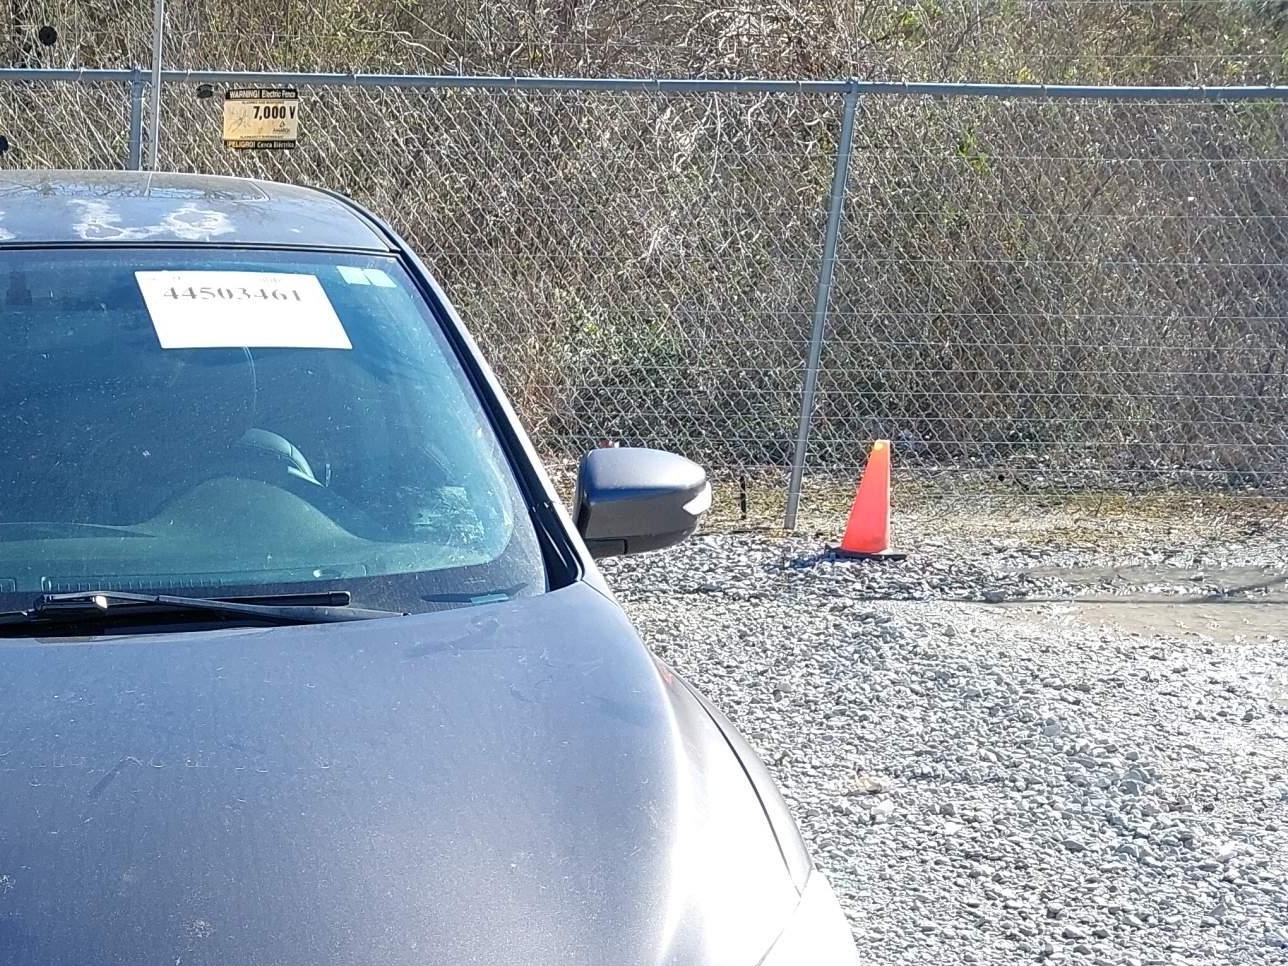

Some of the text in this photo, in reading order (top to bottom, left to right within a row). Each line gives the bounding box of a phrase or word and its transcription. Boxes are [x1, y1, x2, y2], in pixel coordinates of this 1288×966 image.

[229, 90, 296, 99] WARNING! Electric Fence
[253, 106, 296, 120] 7,000 V
[163, 286, 304, 302] 44503461
